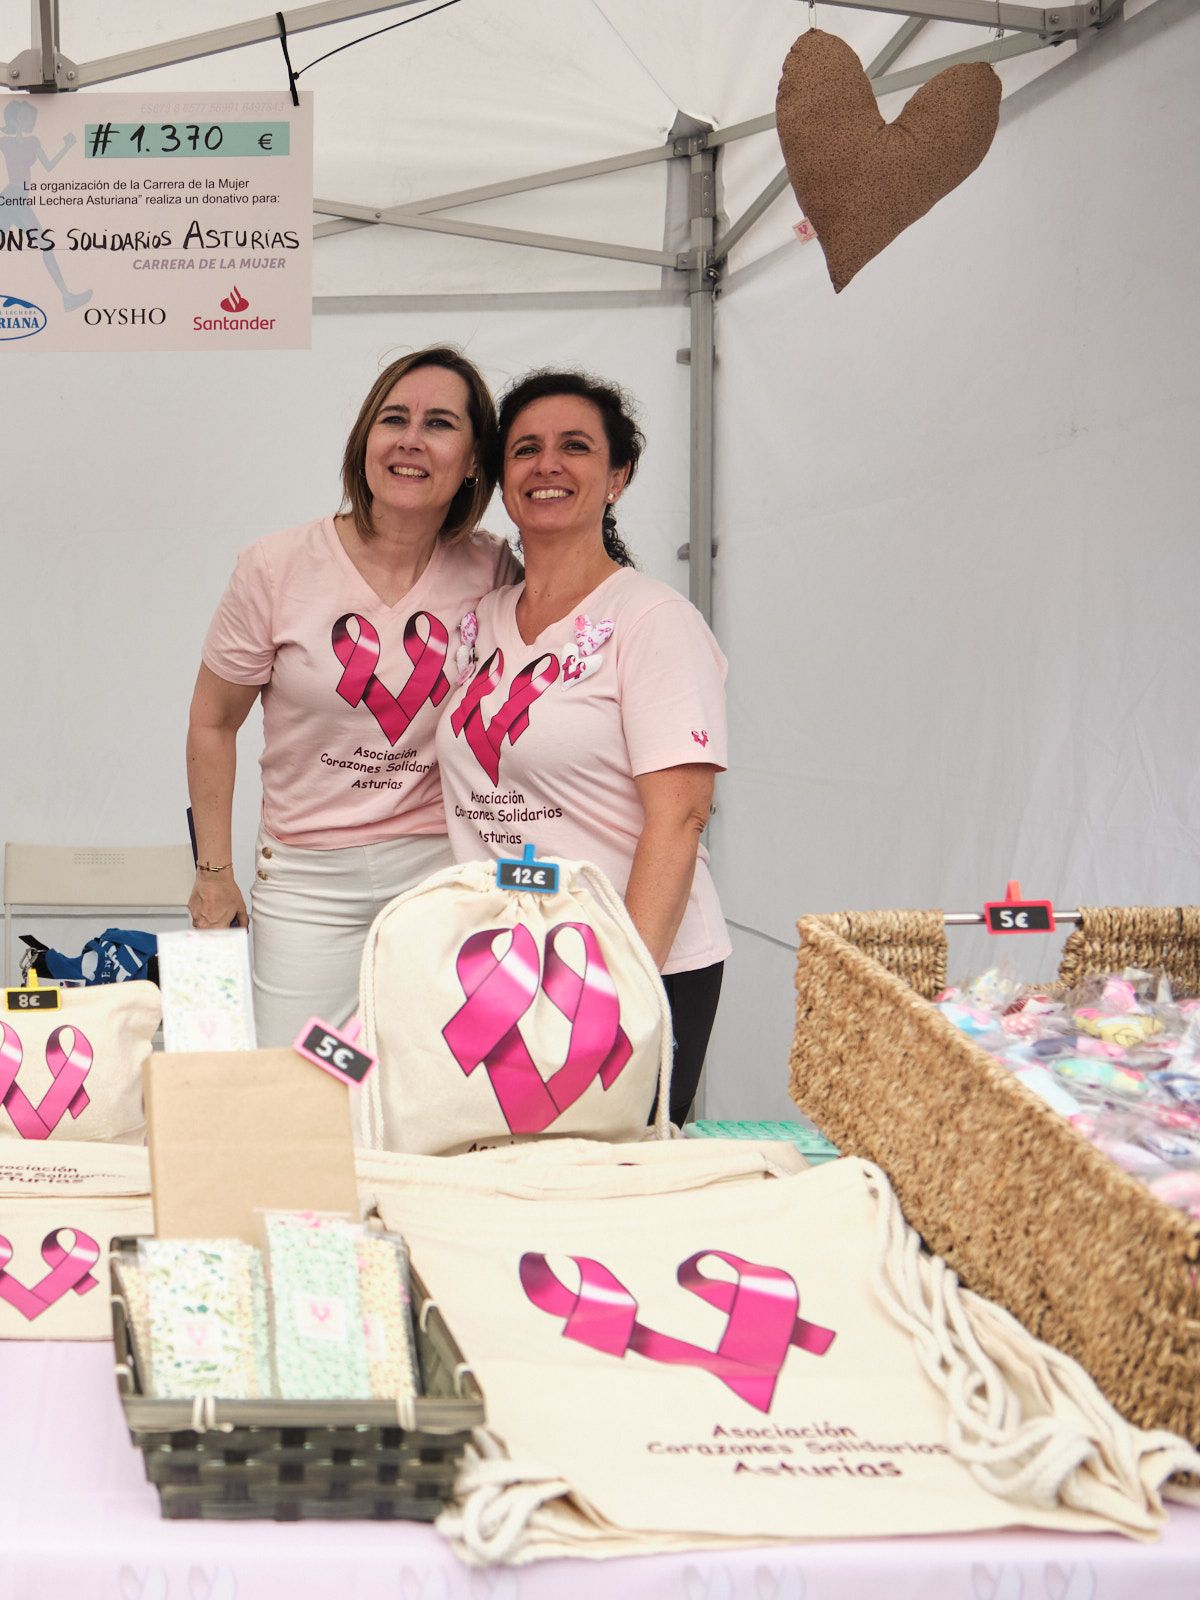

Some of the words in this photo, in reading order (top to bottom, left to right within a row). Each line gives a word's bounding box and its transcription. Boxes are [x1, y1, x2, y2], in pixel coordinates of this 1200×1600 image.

[257, 133, 273, 150] €
[23, 181, 37, 191] La
[40, 180, 110, 193] organización
[113, 180, 127, 190] de
[130, 180, 140, 190] la
[143, 179, 185, 190] Carrera
[188, 179, 202, 189] de
[205, 178, 215, 189] la
[218, 178, 250, 191] Mujer
[40, 195, 84, 206] Lechera
[145, 194, 182, 204] realiza
[185, 195, 199, 204] un
[202, 193, 249, 204] donativo
[252, 194, 280, 205] para:
[132, 259, 195, 270] CARRERA
[198, 258, 216, 269] DE
[219, 258, 236, 269] LA
[239, 257, 286, 269] MUJER
[84, 307, 167, 326] OYSHO
[193, 316, 277, 332] Santander
[353, 746, 417, 761] Asociación
[320, 752, 382, 774] Corazones
[352, 778, 403, 790] Asturias
[498, 806, 563, 822] Solidarios
[511, 867, 546, 885] 12€
[1000, 910, 1029, 928] 5€
[18, 994, 40, 1008] 8€
[315, 1034, 355, 1070] 5€
[712, 1421, 857, 1439] Asociación
[646, 1440, 794, 1456] Corazones
[804, 1440, 953, 1456] Solidarios
[732, 1457, 903, 1478] Asturias
